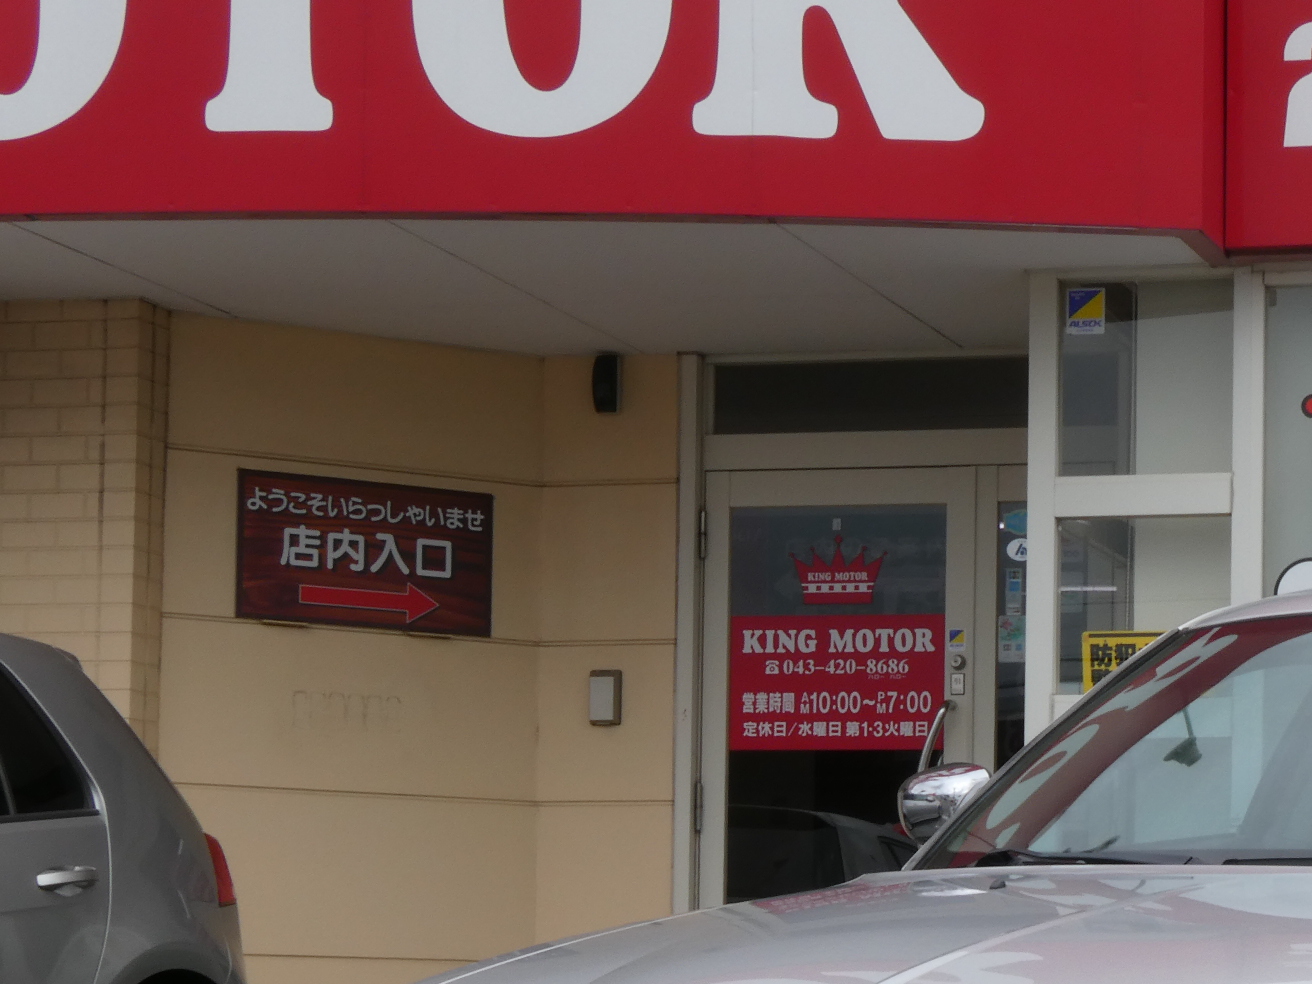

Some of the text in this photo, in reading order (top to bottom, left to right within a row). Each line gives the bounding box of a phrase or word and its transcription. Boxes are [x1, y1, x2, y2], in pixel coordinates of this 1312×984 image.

[280, 524, 452, 579] 店内入口
[807, 571, 868, 581] KING MOTOR
[742, 628, 935, 654] KING MOTOR
[783, 658, 909, 675] 043-420-8686
[742, 692, 795, 714] 営業時間
